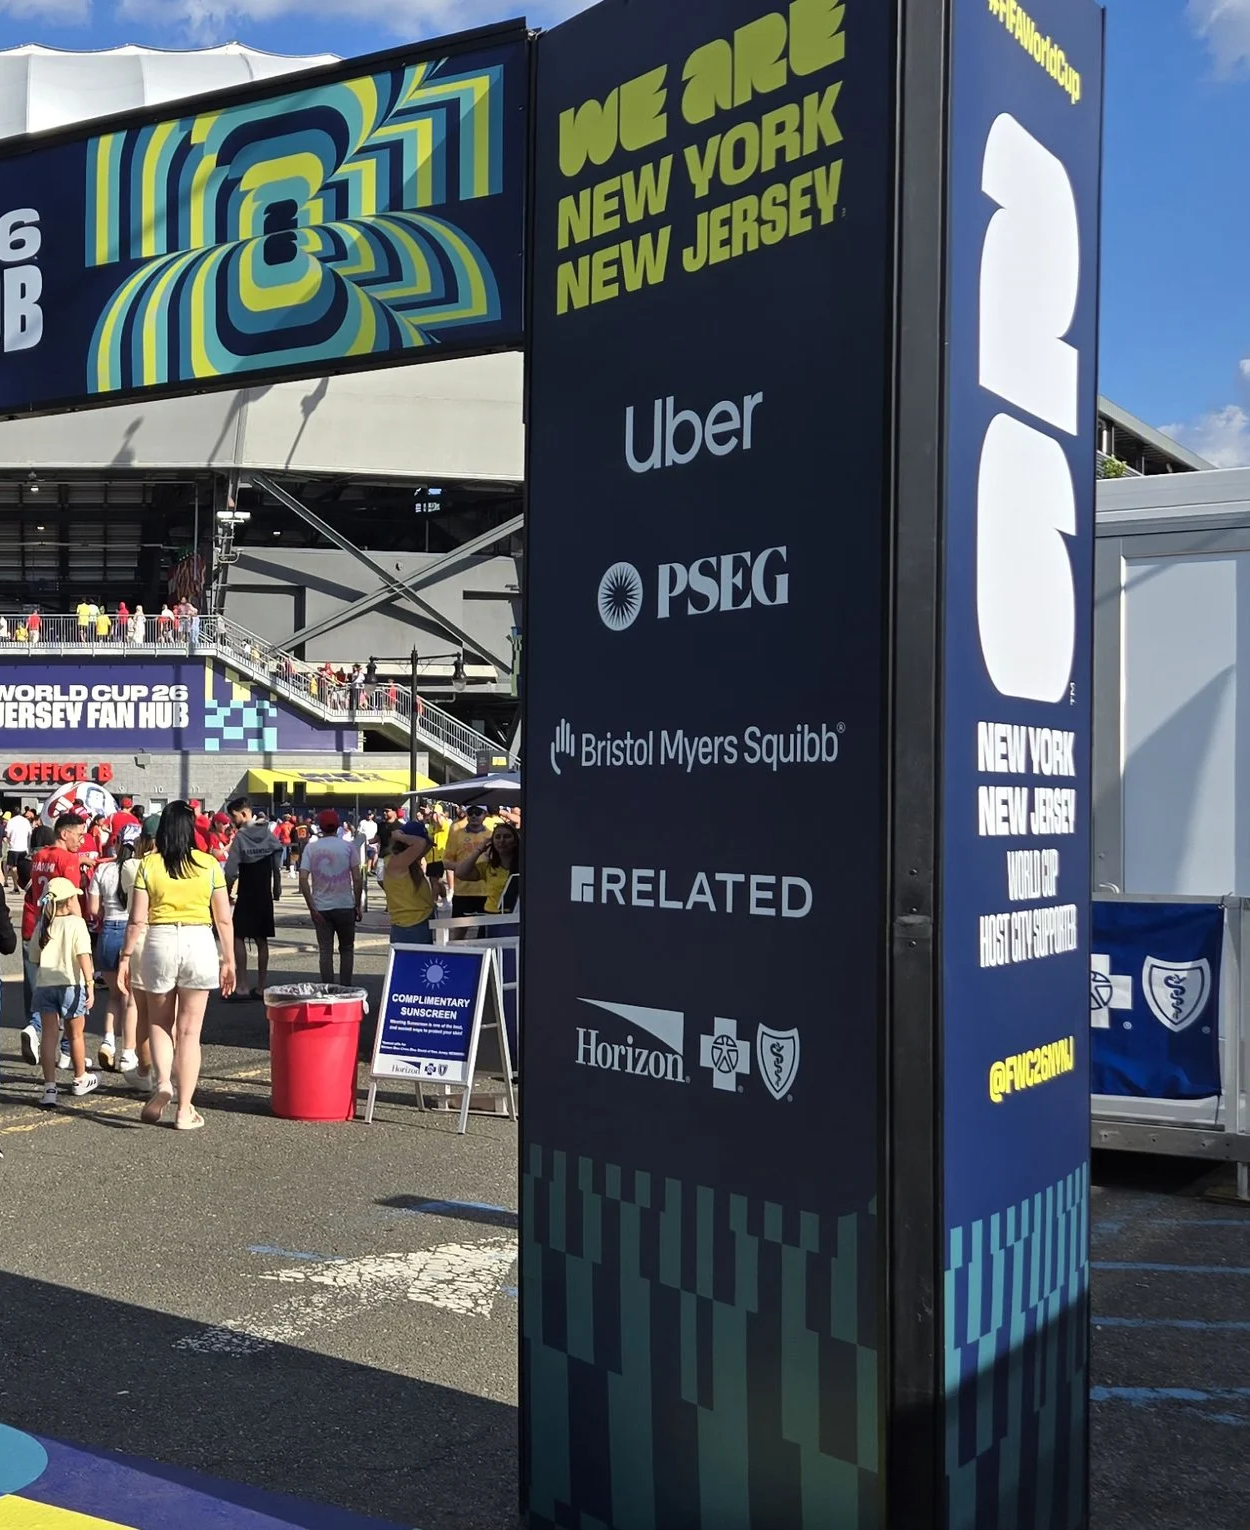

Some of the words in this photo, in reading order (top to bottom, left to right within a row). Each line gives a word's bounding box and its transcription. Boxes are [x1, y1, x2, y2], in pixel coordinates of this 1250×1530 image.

[559, 64, 668, 177] WE
[681, 0, 845, 125] ARE
[557, 154, 673, 250] NEW
[683, 80, 844, 199] YORK
[556, 225, 672, 315] NEW
[682, 159, 843, 273] JERSEY
[624, 392, 763, 473] Uber
[657, 545, 789, 619] PSEG
[87, 702, 134, 728] FAN
[139, 702, 189, 728] HUB
[91, 685, 148, 701] CUP
[152, 685, 189, 701] 26
[8, 763, 88, 781] OFFICE
[98, 763, 113, 782] B
[580, 730, 654, 768] Bristol
[661, 729, 738, 773] Myers
[744, 724, 839, 771] Squibb
[978, 721, 1026, 774] NEW
[1028, 727, 1075, 777] YORK
[153, 785, 164, 793] 10
[978, 786, 1028, 836] NEW
[1030, 787, 1076, 835] JERSEY
[600, 866, 813, 919] RELATED
[1007, 850, 1040, 900] WORLD
[1041, 849, 1059, 897] CUP
[980, 913, 1010, 968] HOST
[1011, 909, 1033, 962] CITY
[1033, 904, 1077, 957] SUPPORTER
[392, 994, 470, 1008] COMPLIMENTARY
[401, 1007, 457, 1020] SUNSCREEN
[392, 1065, 420, 1074] Horizon
[575, 1026, 685, 1083] Horizon
[989, 1036, 1074, 1103] @FWC26NYNJ
